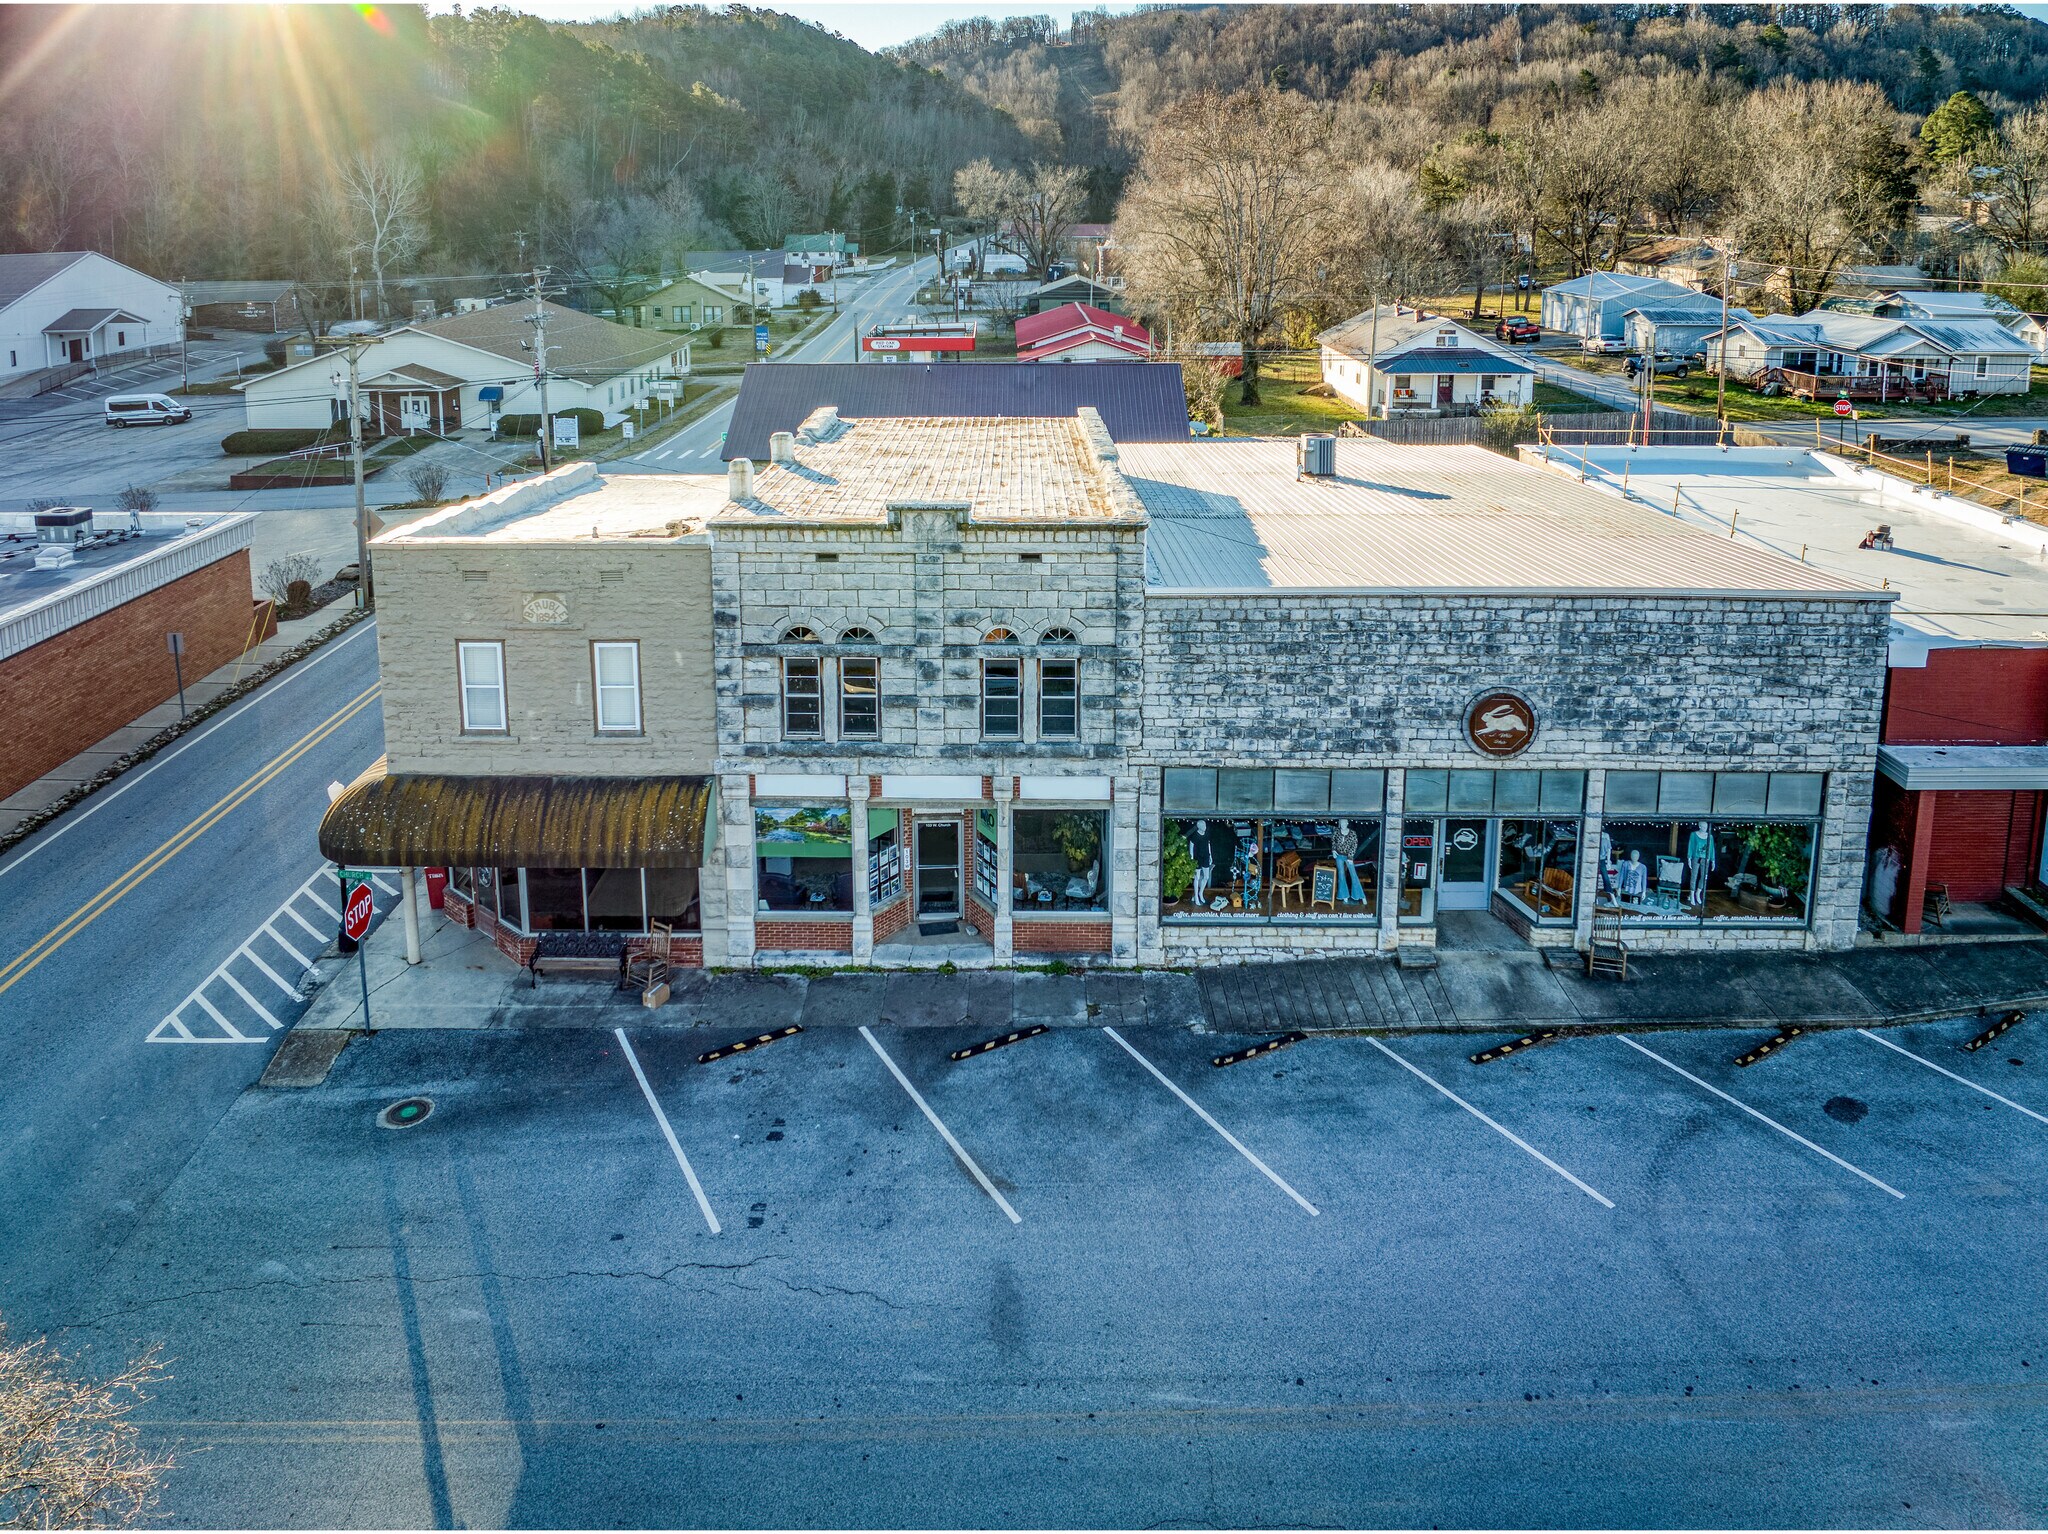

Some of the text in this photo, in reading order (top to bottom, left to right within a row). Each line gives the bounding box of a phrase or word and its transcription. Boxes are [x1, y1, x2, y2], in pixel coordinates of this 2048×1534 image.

[1405, 837, 1432, 846] OPEN
[339, 871, 364, 879] CHURCH
[347, 894, 372, 930] STOP
